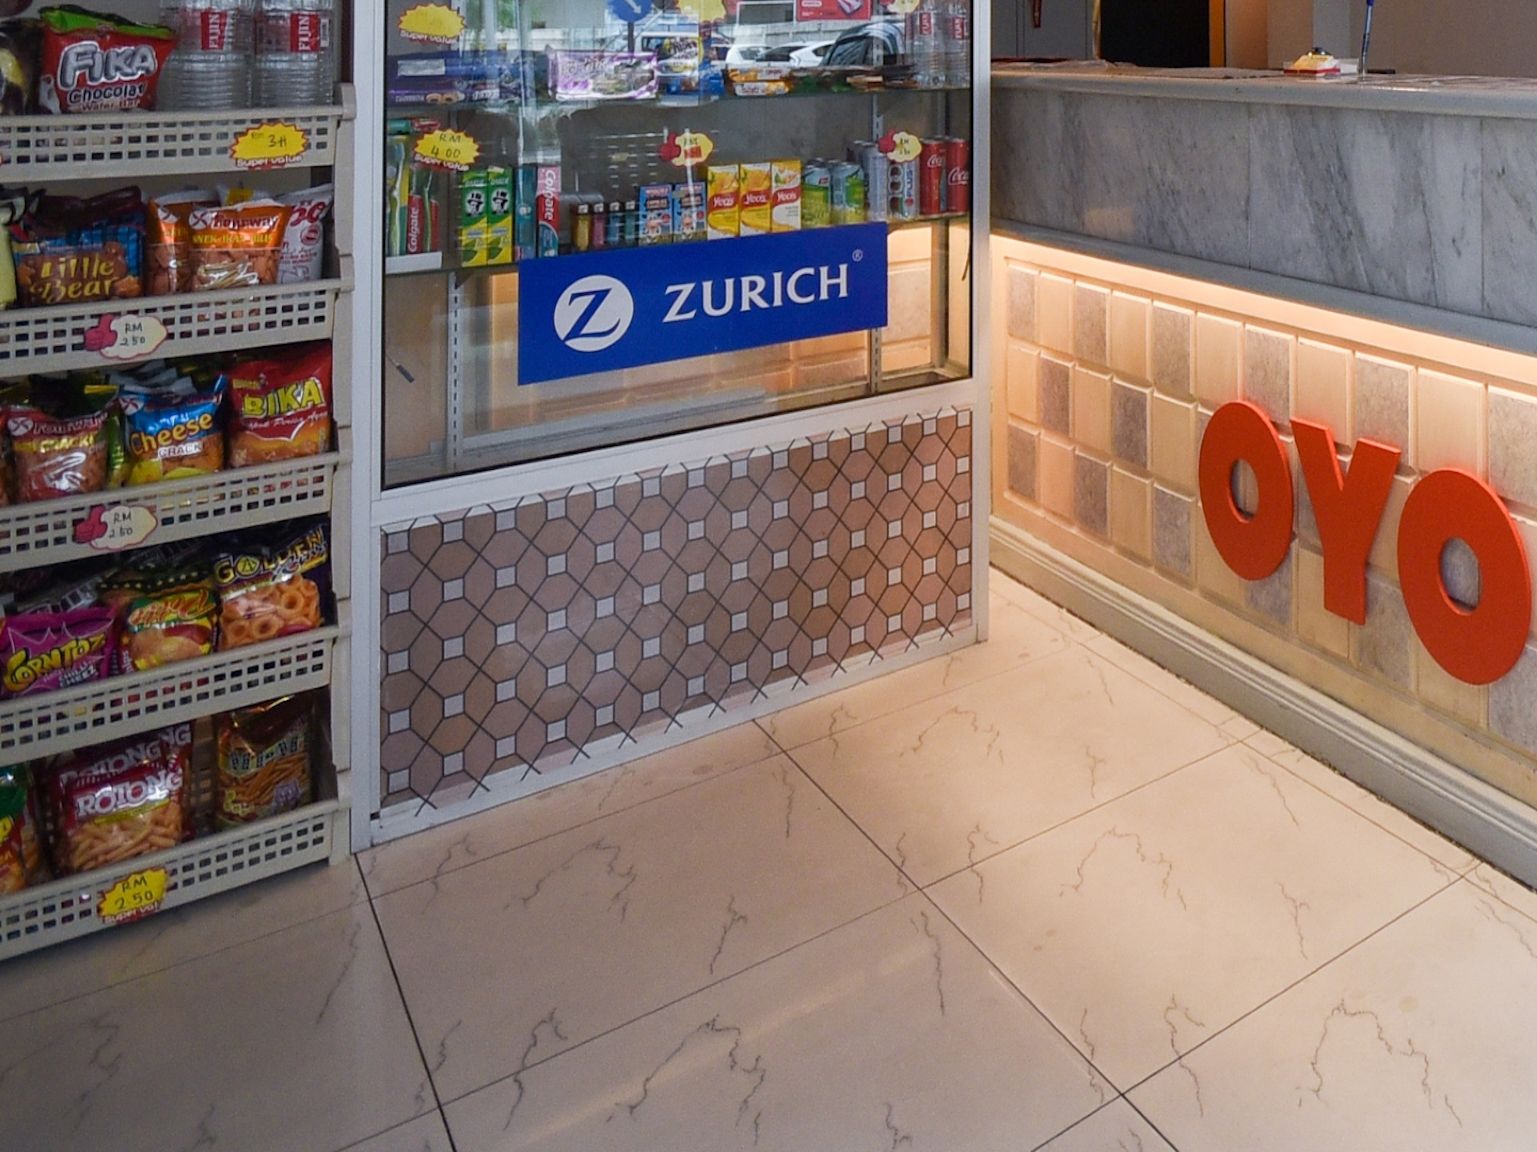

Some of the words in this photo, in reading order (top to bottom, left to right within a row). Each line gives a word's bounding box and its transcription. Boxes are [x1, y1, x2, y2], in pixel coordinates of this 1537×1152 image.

[57, 40, 158, 90] FIKA
[544, 168, 556, 222] Colgate
[407, 207, 420, 253] Colgate
[40, 256, 115, 280] Little
[662, 263, 850, 324] ZURICH
[124, 322, 143, 335] RM
[243, 377, 326, 419] BIKA
[130, 412, 214, 456] Cheese
[1197, 399, 1533, 687] OYO
[3, 632, 107, 694] CORNTOZ
[122, 876, 148, 893] RM
